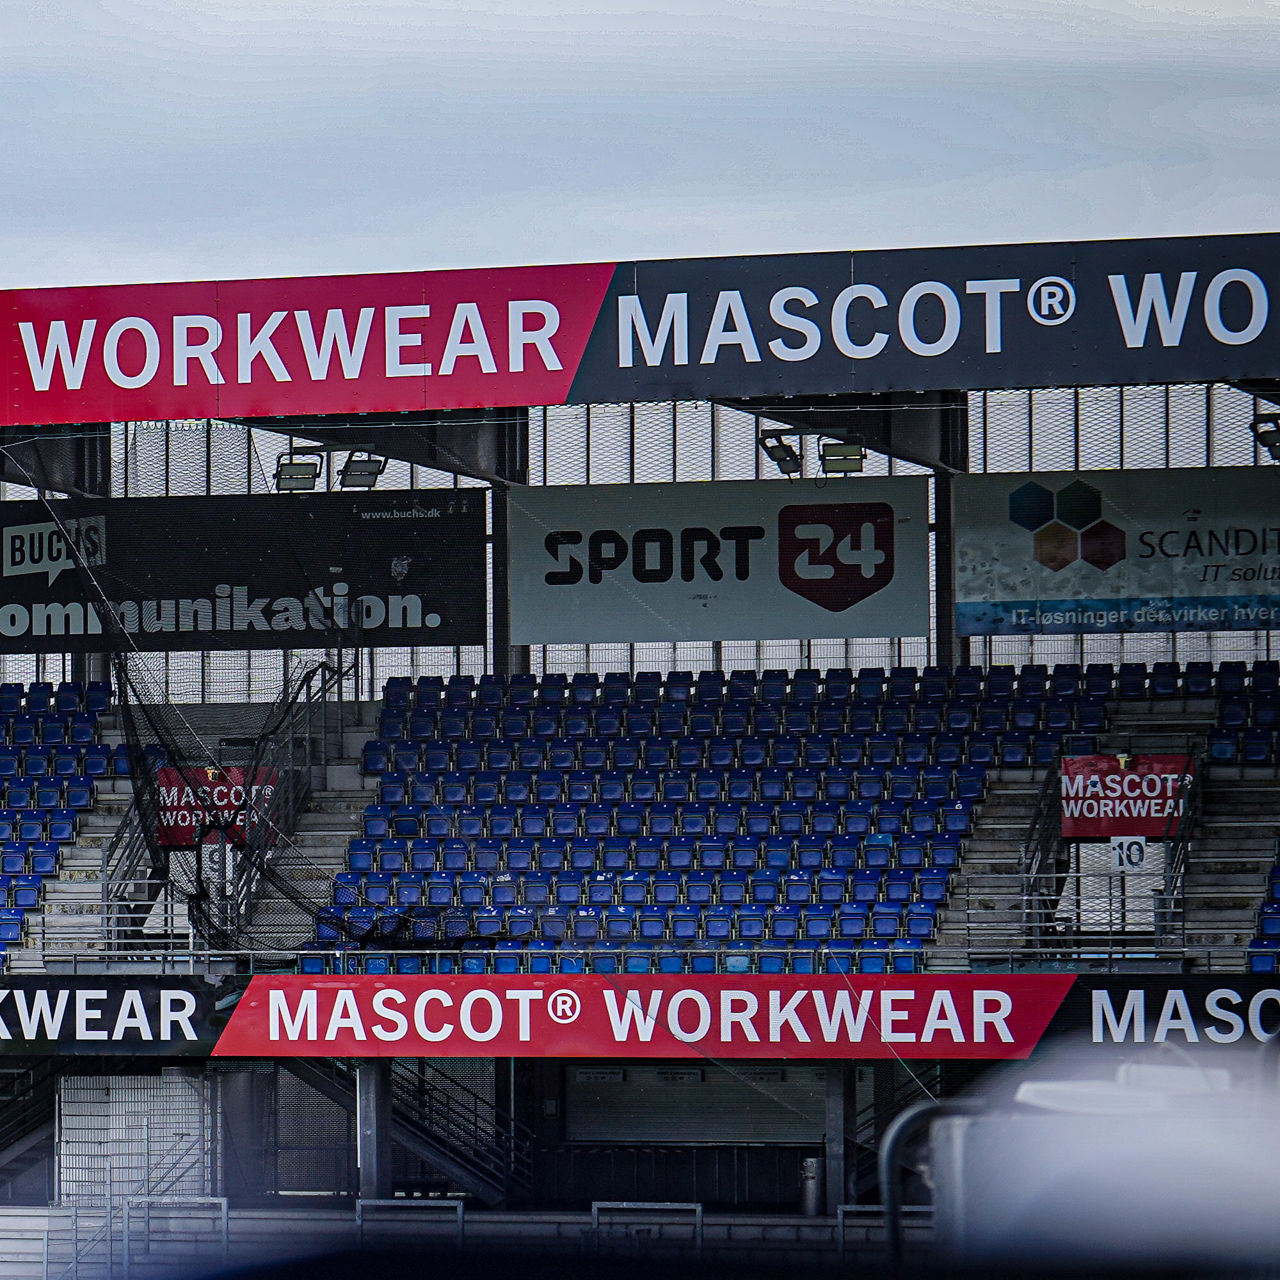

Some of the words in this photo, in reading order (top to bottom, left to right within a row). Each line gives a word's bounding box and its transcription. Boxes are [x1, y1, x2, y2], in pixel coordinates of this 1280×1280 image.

[18, 300, 564, 392] WORKWEAR
[361, 508, 440, 519] www.buchs.dk
[545, 526, 765, 585] SPORT
[795, 522, 886, 579] 24
[1200, 565, 1227, 582] IT
[1171, 605, 1228, 622] virker
[1113, 841, 1145, 867] 10
[603, 988, 1015, 1044] WORKWEAR
